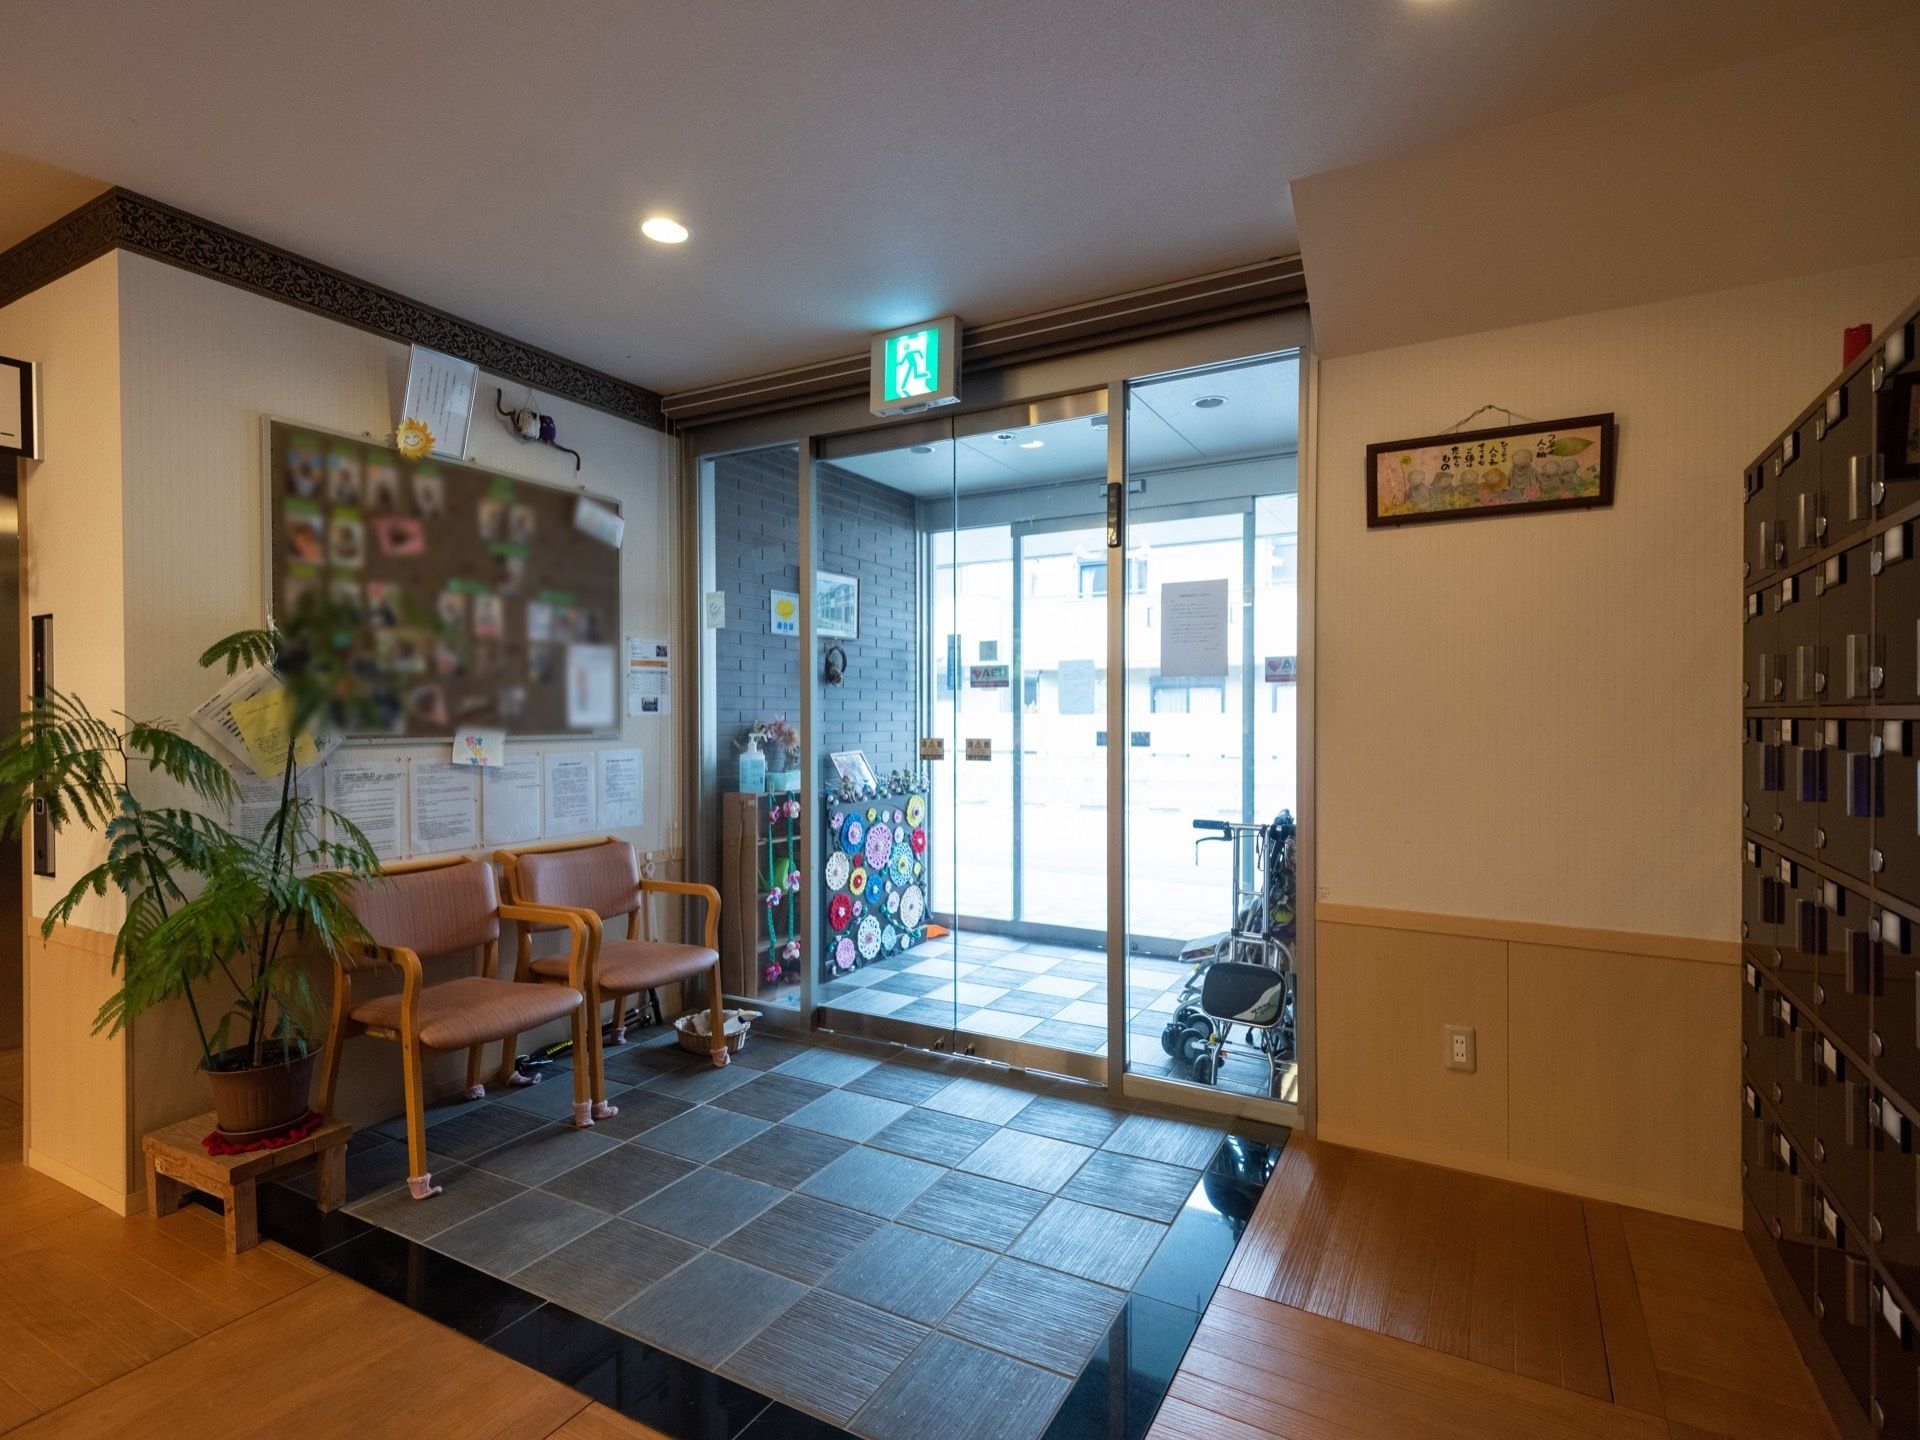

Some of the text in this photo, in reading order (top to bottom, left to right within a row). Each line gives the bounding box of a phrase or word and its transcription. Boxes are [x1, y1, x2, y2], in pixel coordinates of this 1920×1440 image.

[1441, 455, 1450, 471] もの
[1451, 446, 1462, 468] たから
